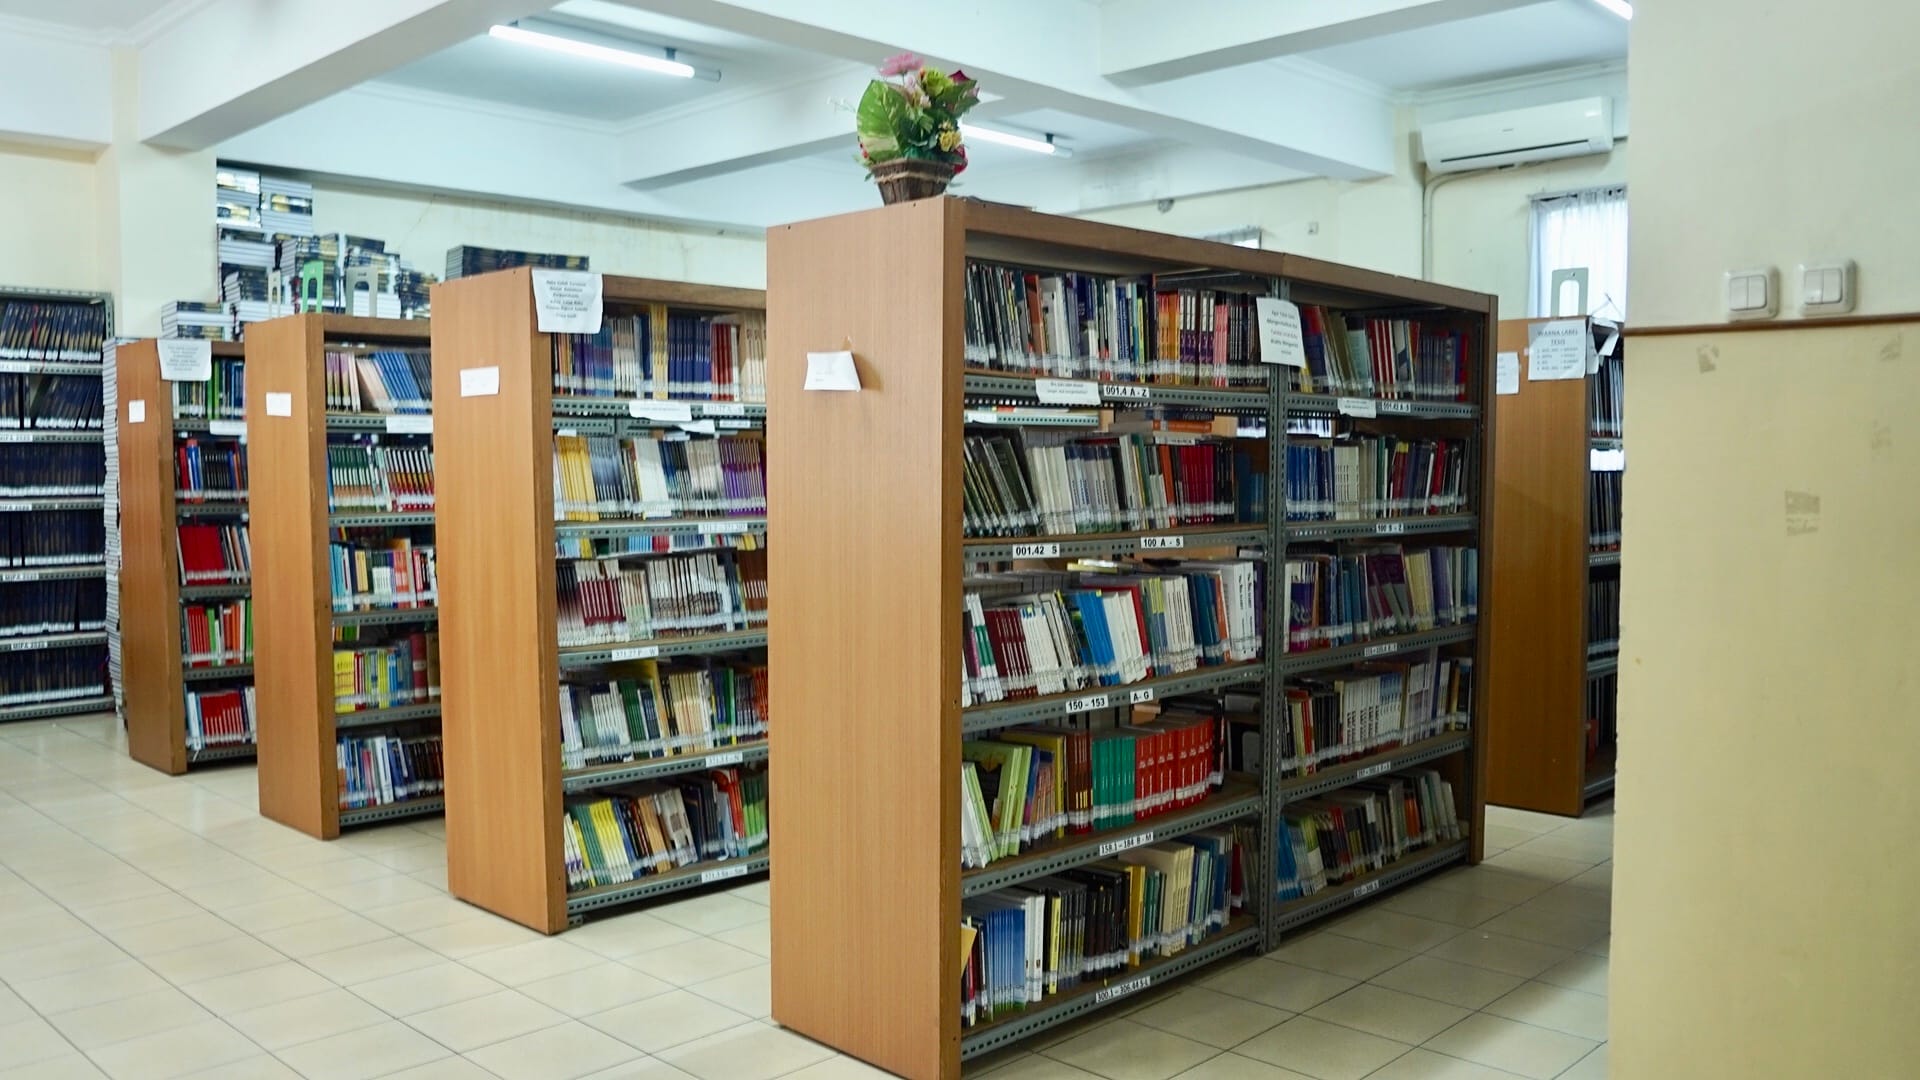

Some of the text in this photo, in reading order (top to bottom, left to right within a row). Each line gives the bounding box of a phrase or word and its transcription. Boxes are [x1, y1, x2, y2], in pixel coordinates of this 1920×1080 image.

[1105, 386, 1127, 396] 001.4
[1130, 387, 1136, 397] A
[1142, 388, 1147, 398] Z
[1143, 538, 1157, 547] 100
[1160, 538, 1166, 547] A
[1176, 537, 1181, 546] S
[1015, 544, 1057, 556] 001.42 S
[1143, 691, 1149, 700] G
[1068, 701, 1083, 711] 150
[1091, 697, 1105, 708] 153
